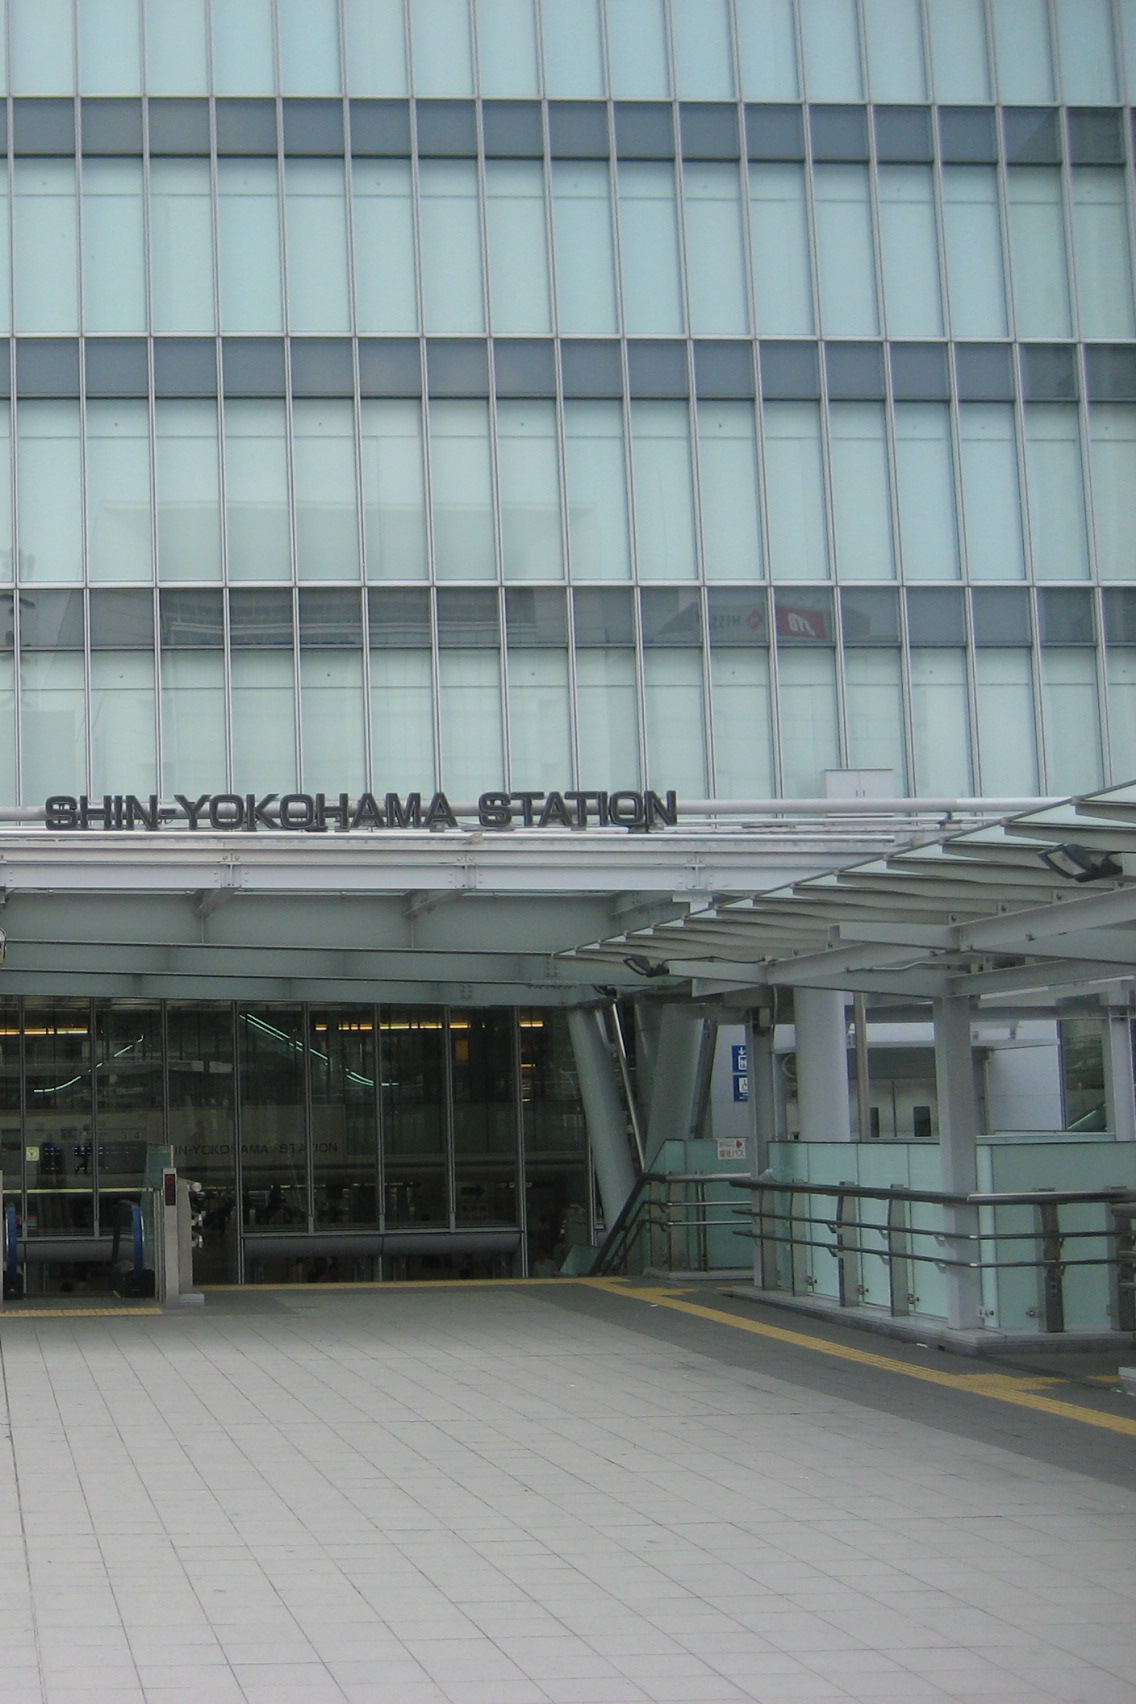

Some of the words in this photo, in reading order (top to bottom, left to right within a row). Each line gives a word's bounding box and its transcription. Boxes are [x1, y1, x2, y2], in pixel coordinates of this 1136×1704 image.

[45, 791, 457, 831] SHIN-YOKOHAMA
[477, 791, 678, 829] STATION
[279, 1142, 338, 1154] STAION
